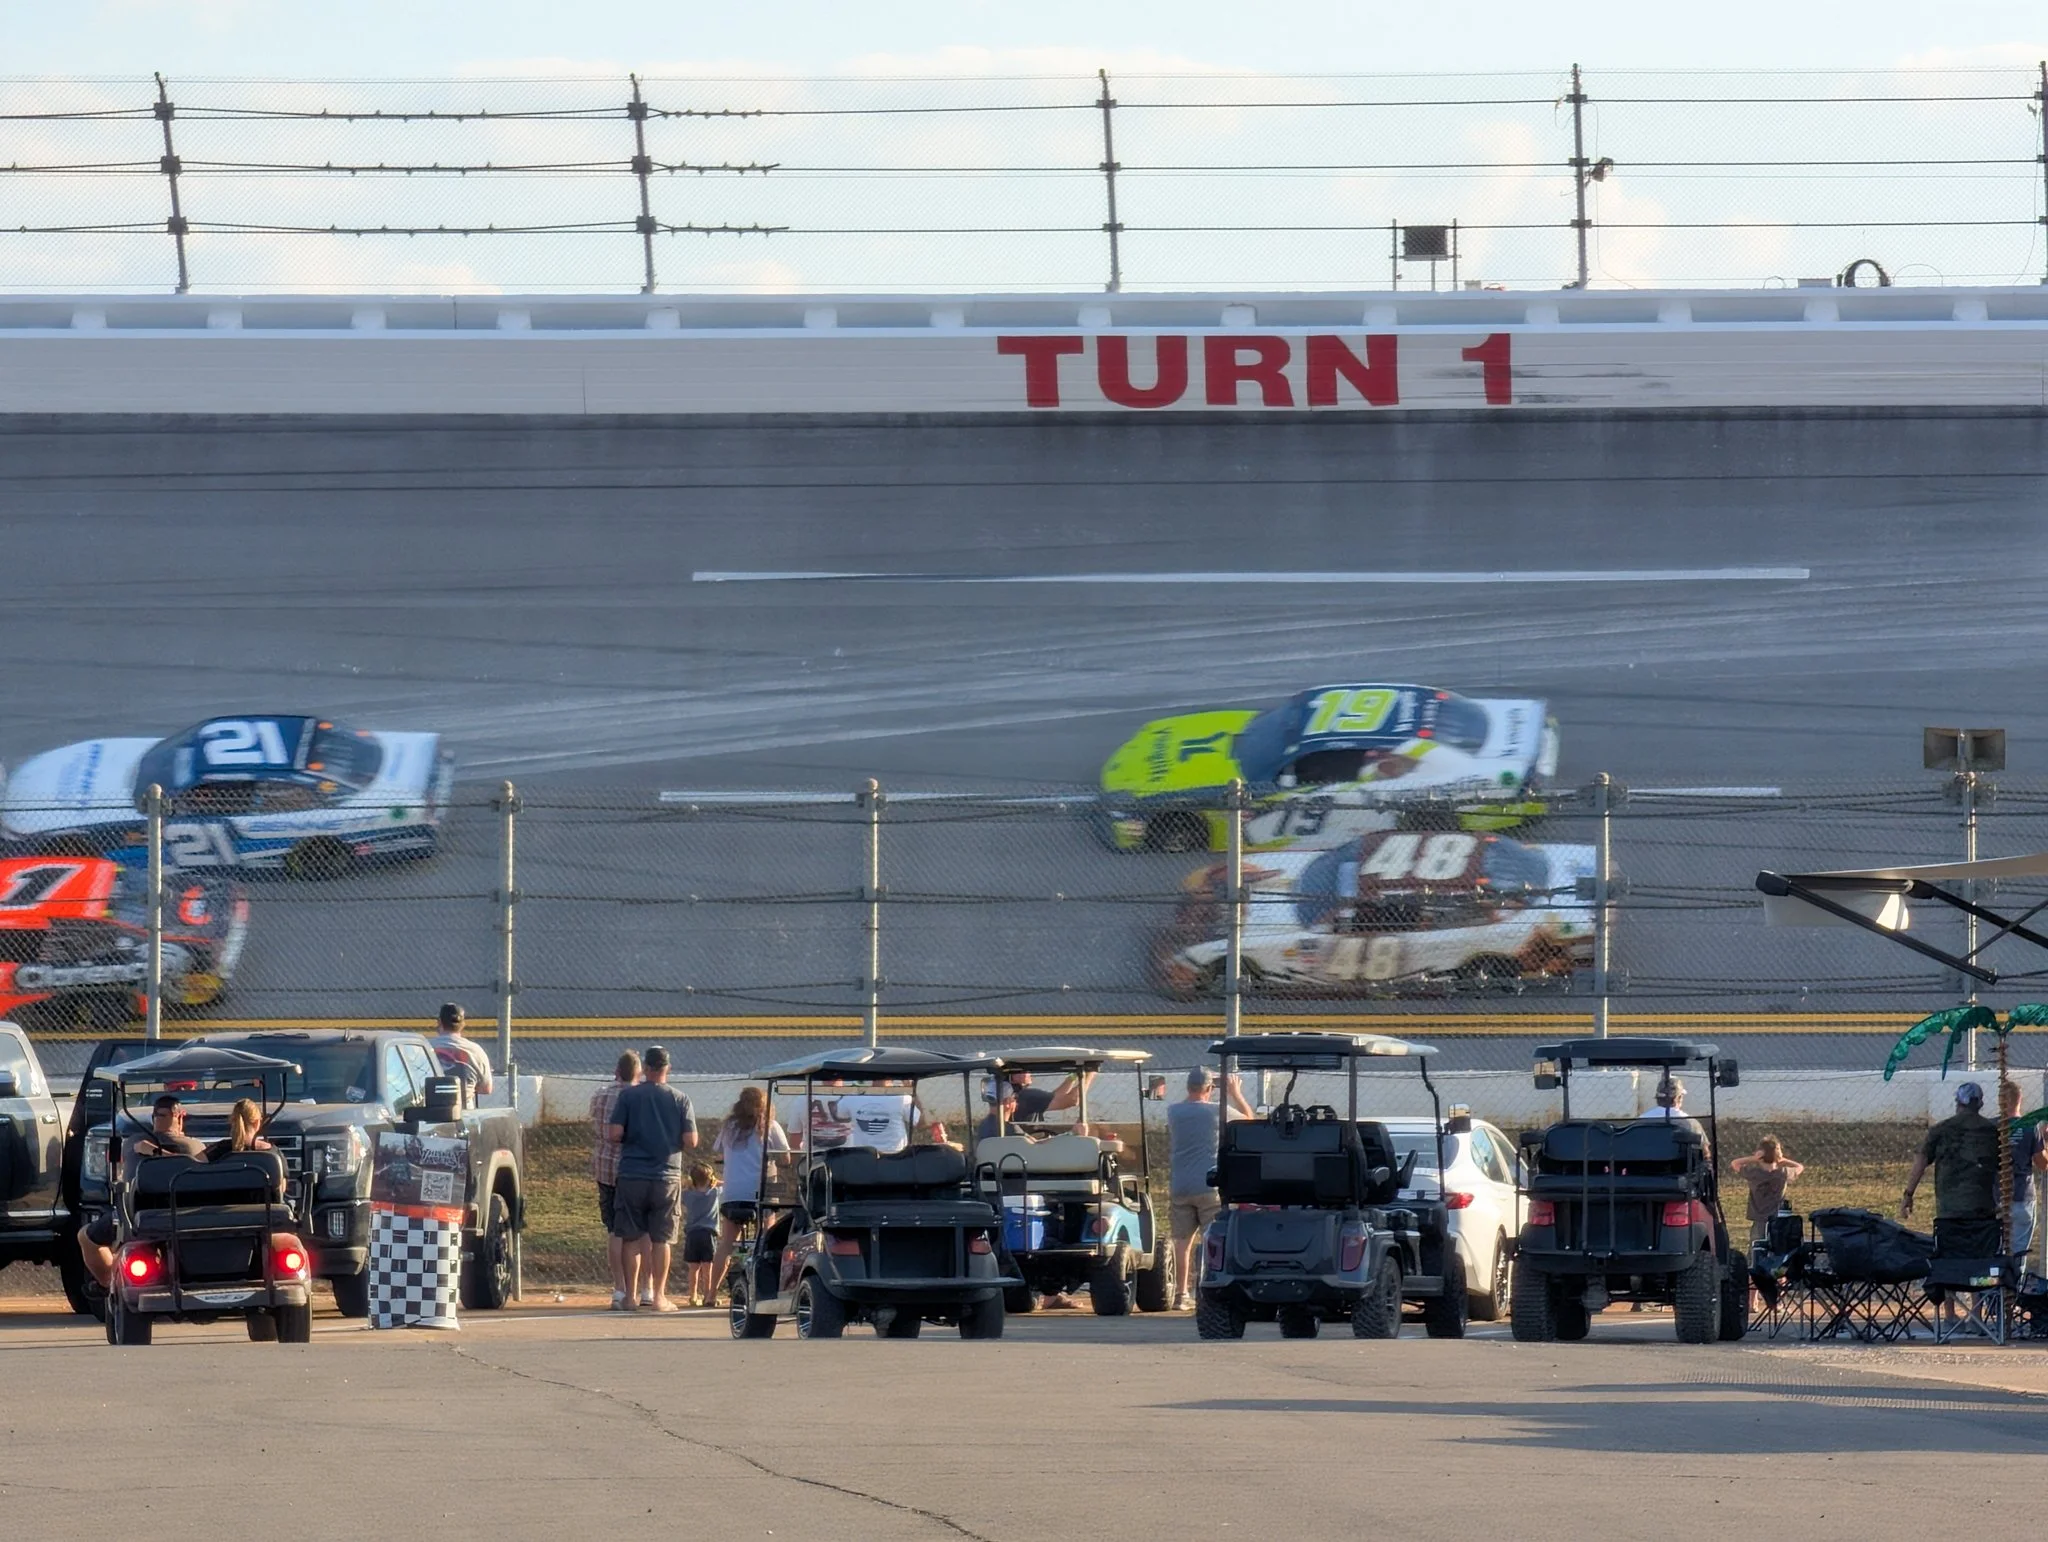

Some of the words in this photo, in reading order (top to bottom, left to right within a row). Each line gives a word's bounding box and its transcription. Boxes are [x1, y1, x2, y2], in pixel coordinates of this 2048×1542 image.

[997, 333, 1400, 408] TURN
[1462, 333, 1512, 406] 1
[1304, 688, 1399, 733] 19
[200, 721, 289, 765] 21
[165, 823, 240, 866] 21
[1360, 833, 1478, 880] 48
[0, 863, 86, 911] 1
[1325, 937, 1400, 981] 48
